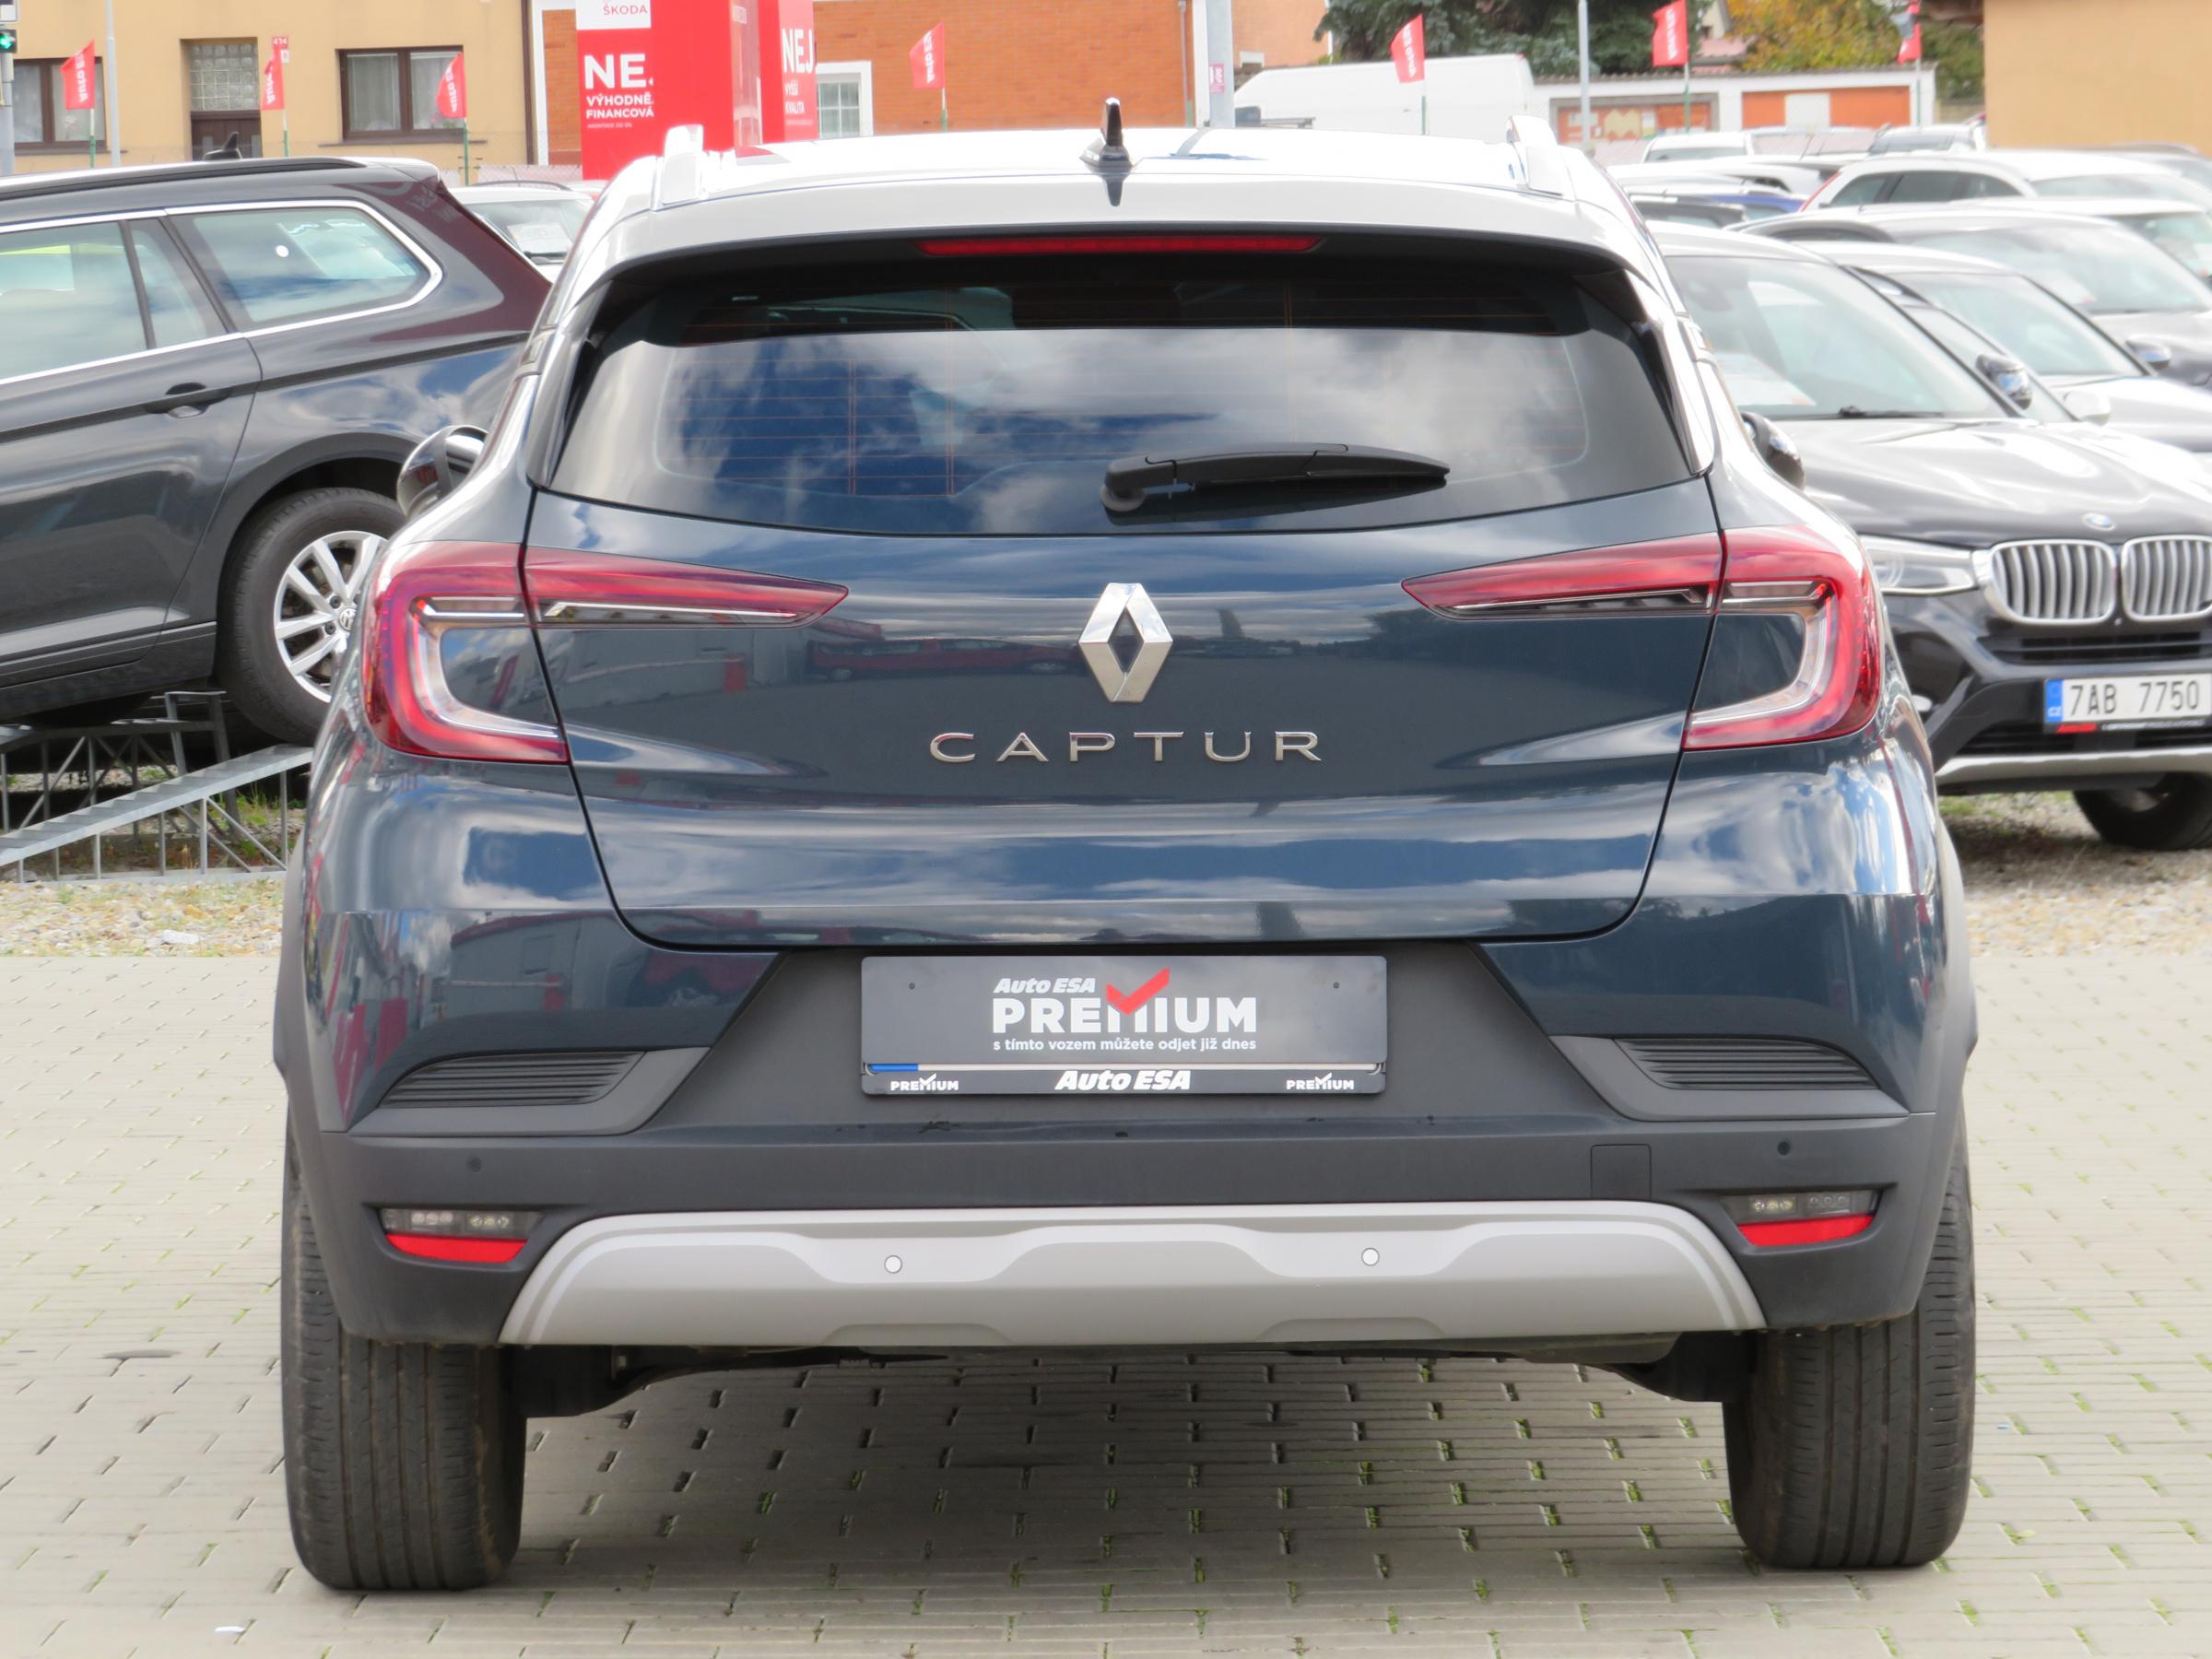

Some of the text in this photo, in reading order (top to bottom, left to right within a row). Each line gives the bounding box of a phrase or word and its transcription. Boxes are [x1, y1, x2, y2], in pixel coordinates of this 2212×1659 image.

[603, 4, 648, 16] ŠKODA
[586, 106, 654, 119] FINANCOVÁ
[2070, 679, 2200, 716] 7AB 7750
[929, 732, 1322, 763] CAPTUR
[993, 977, 1096, 994] Auto ESA
[993, 996, 1257, 1033] PREMIUM
[994, 1036, 1257, 1052] s tímto vozem můžete odjet již dnes
[889, 1077, 959, 1091] PREMIUM
[1054, 1069, 1191, 1091] Auto ESA
[1286, 1076, 1355, 1090] PREMIUM
